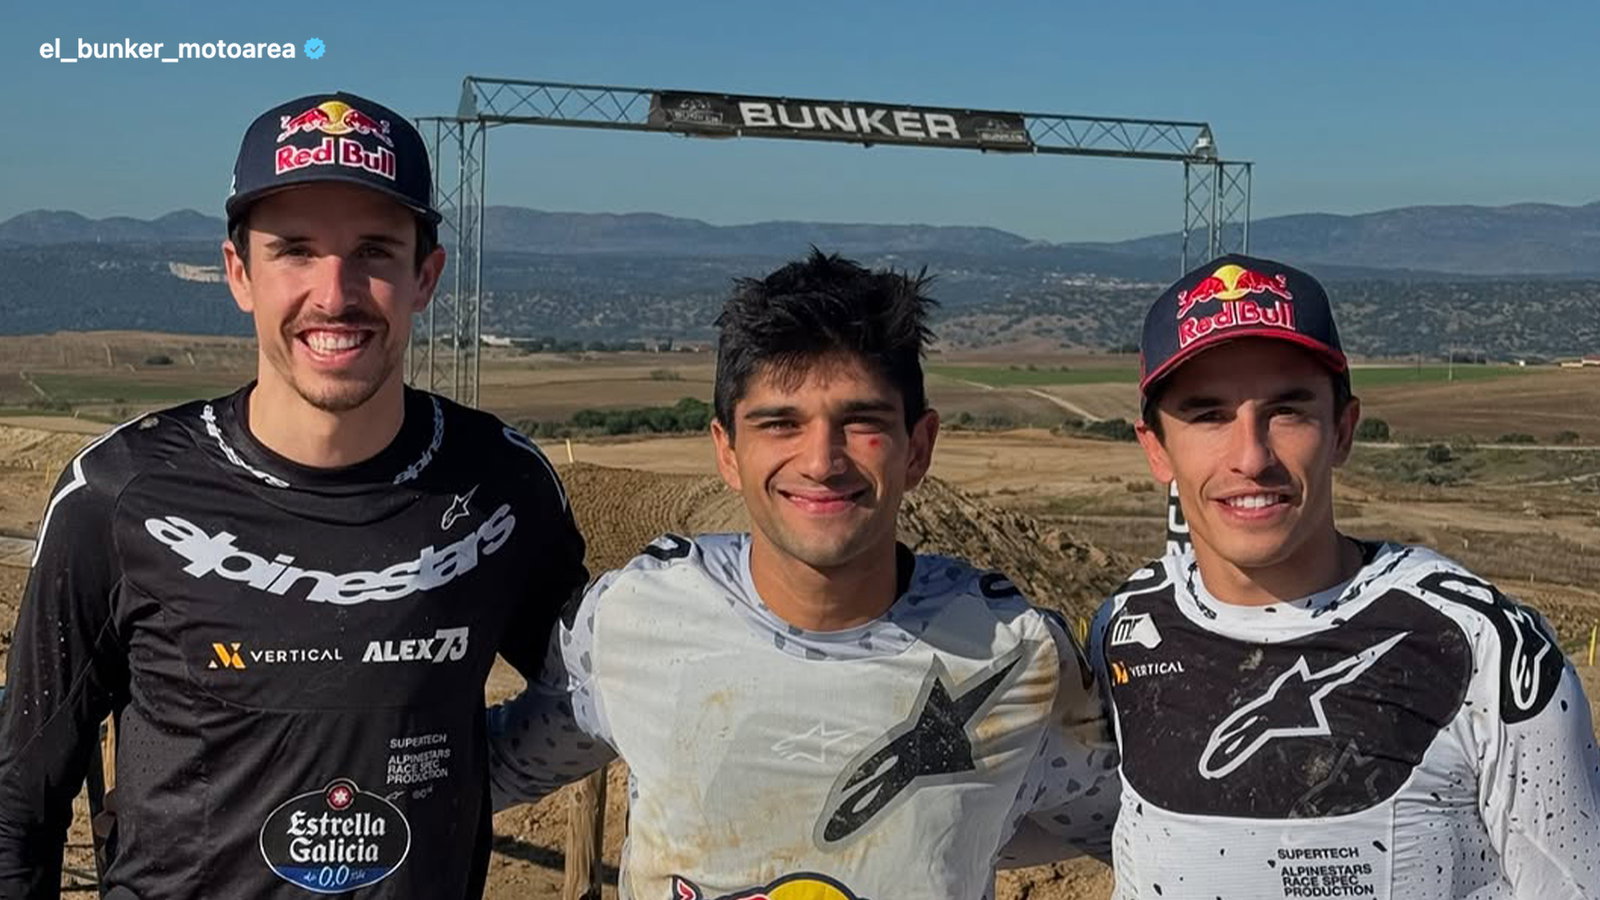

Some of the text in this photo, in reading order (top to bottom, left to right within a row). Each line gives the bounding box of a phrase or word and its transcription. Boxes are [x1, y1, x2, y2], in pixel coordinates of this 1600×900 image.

[738, 102, 961, 140] BUNKER
[275, 137, 397, 181] Red Bull
[1179, 300, 1296, 349] Red Bull
[145, 503, 516, 605] alpinestars
[250, 648, 343, 663] VERTICAL
[1129, 661, 1185, 677] VERTICAL
[387, 763, 419, 775] RACE
[286, 810, 386, 837] Estrella
[289, 836, 379, 863] Galicia
[1277, 847, 1360, 860] SUPERTECH
[1281, 863, 1373, 877] ALPINESTARS
[1282, 875, 1359, 887] RACE SPEC
[1284, 884, 1374, 897] PRODUCTION
